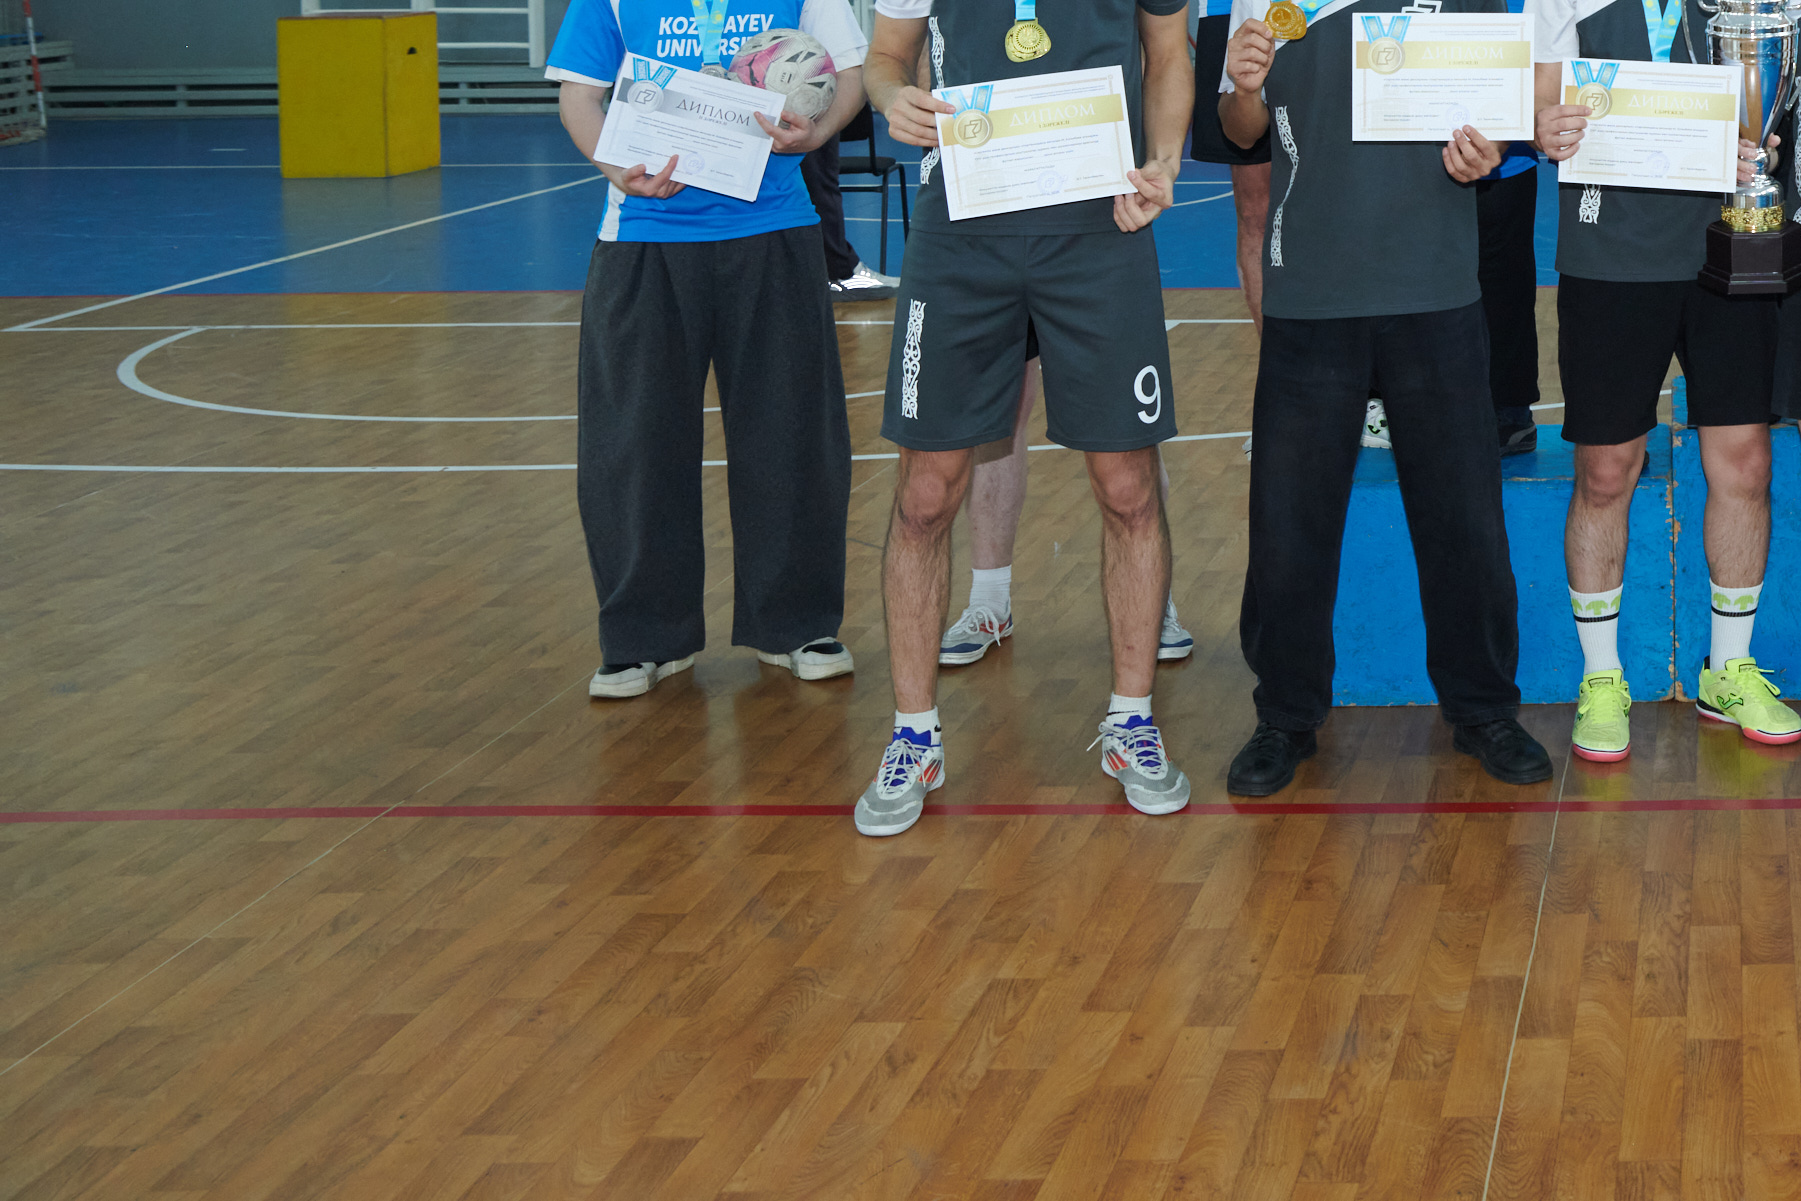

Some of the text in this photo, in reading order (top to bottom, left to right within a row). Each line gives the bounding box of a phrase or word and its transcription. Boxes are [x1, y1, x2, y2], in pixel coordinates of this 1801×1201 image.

[659, 14, 774, 35] KOZAYEV
[1421, 46, 1504, 60] ДИПЛОМ
[676, 99, 750, 127] ДИПЛОМ
[1627, 94, 1710, 111] ДИПЛОМ
[1009, 103, 1096, 127] ДИПЛОМ
[1133, 365, 1162, 424] 9
